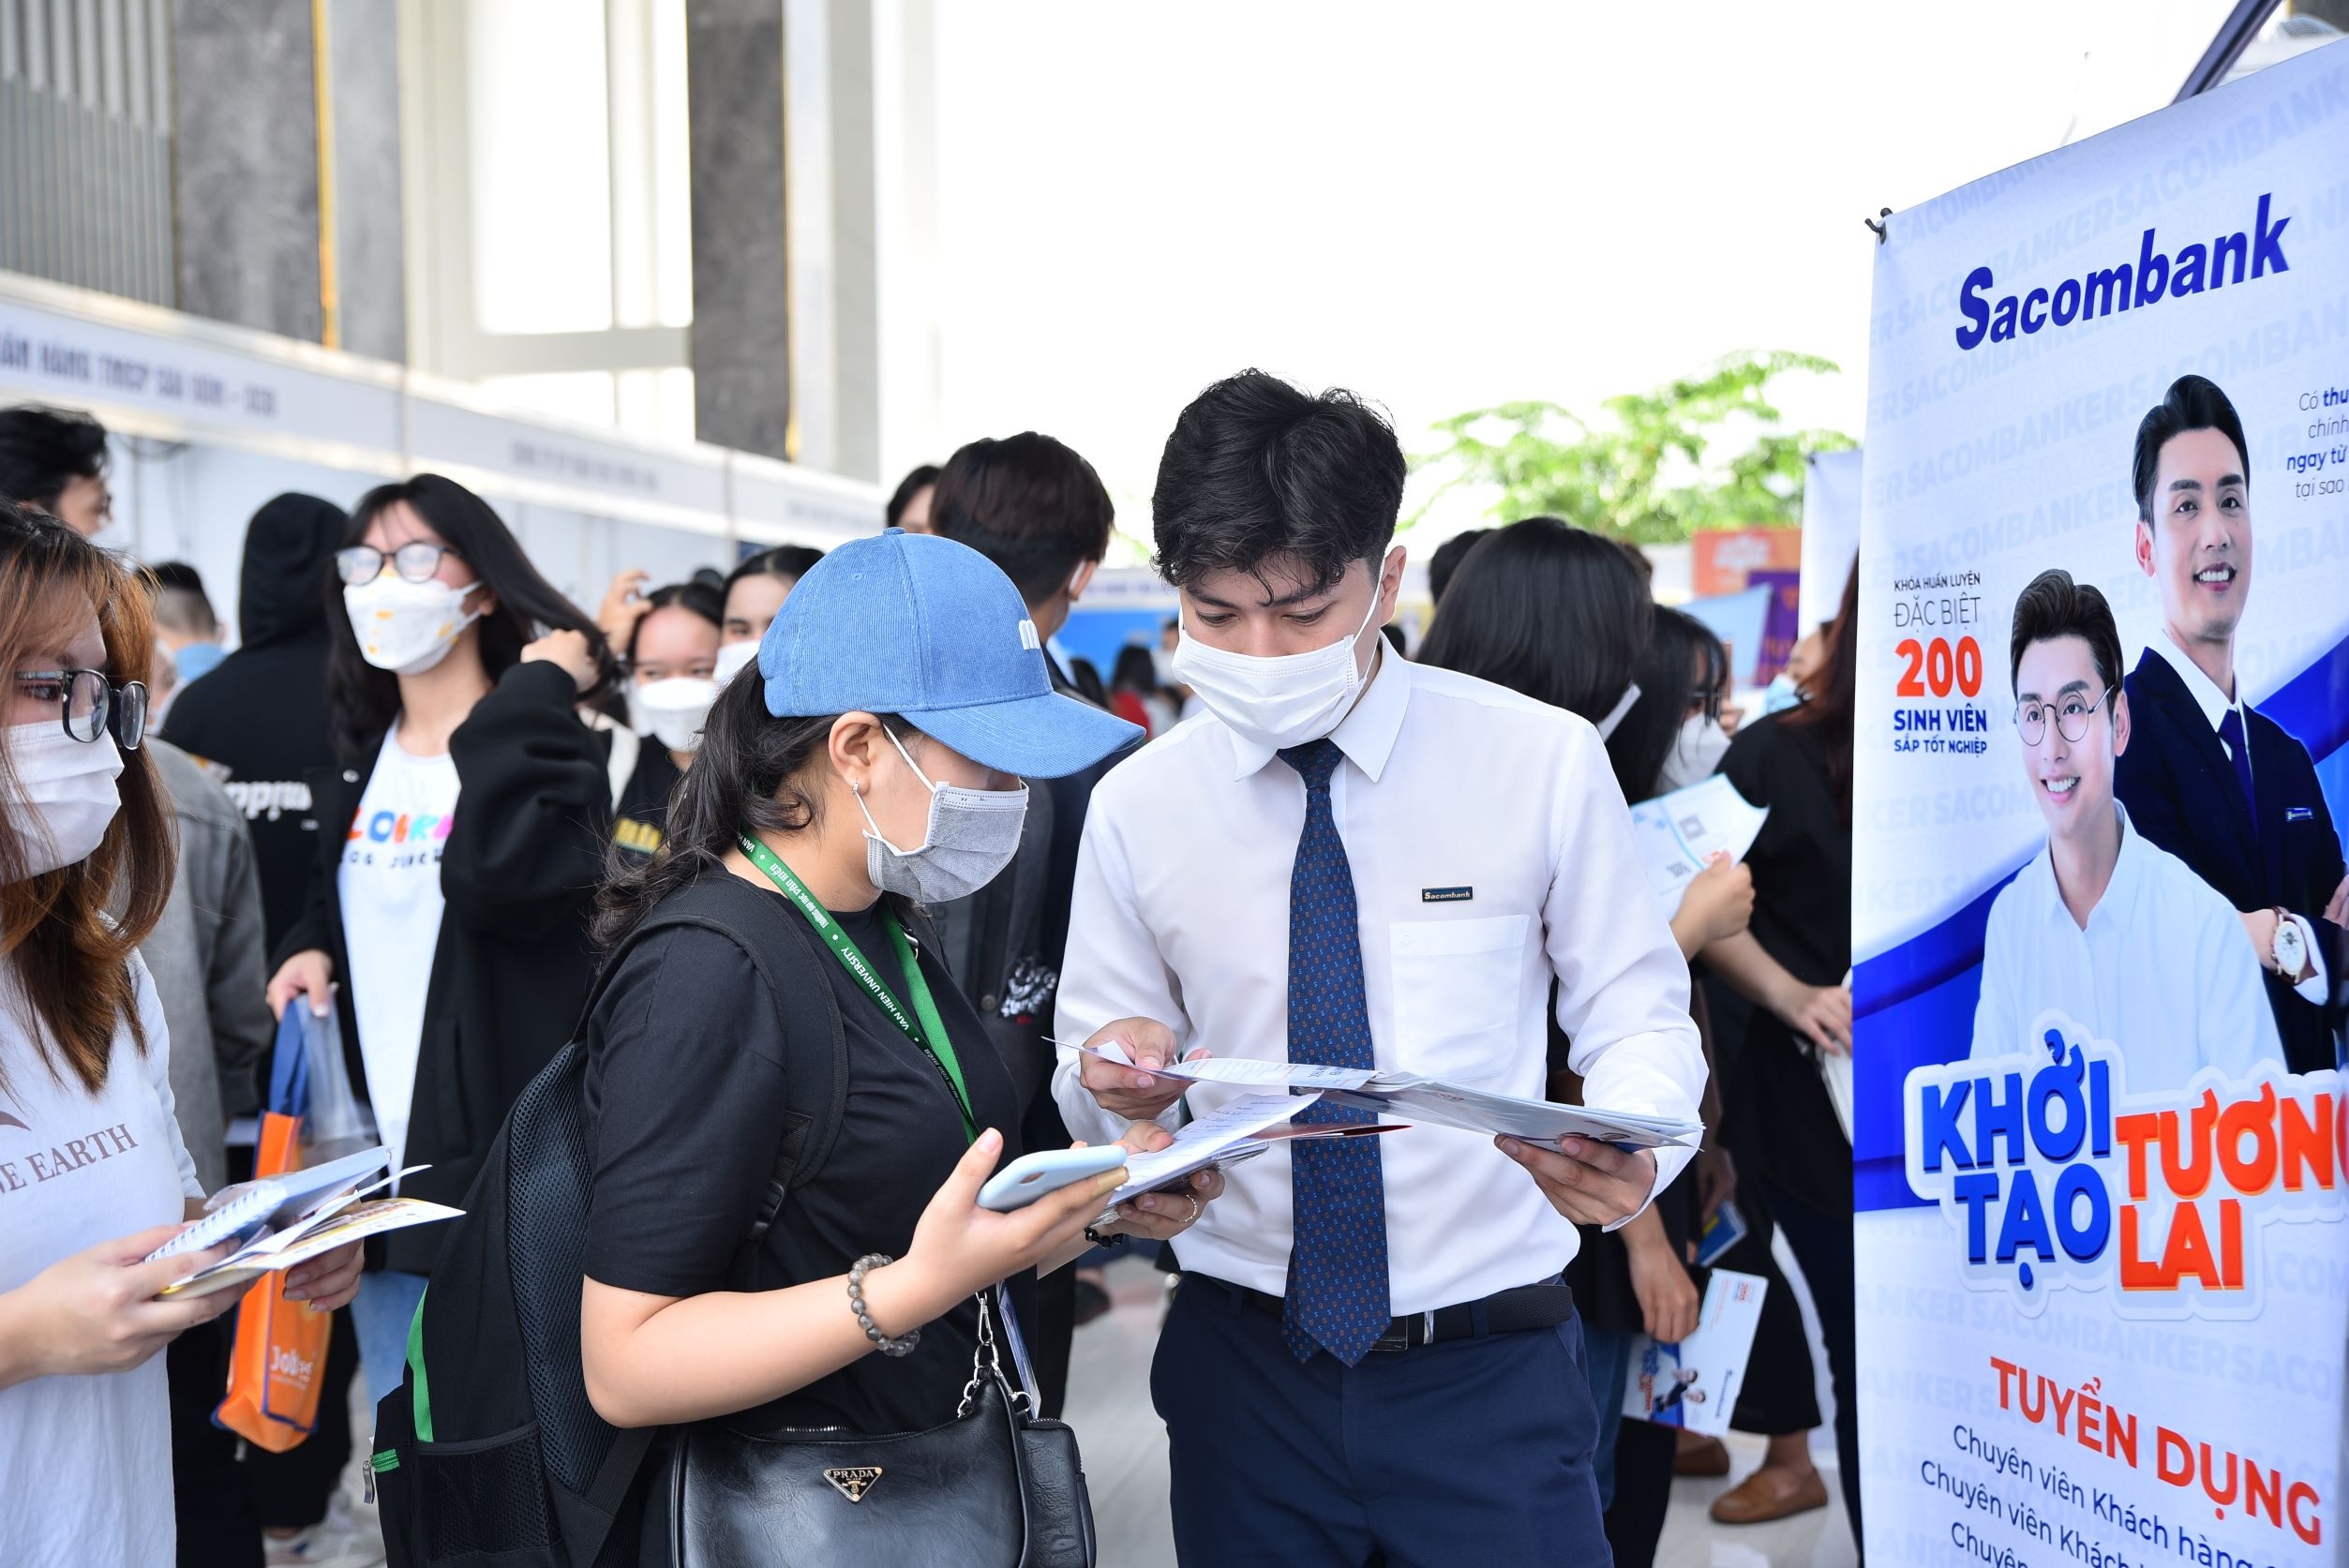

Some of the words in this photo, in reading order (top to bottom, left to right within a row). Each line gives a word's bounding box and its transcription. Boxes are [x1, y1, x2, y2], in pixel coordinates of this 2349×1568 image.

[1955, 192, 2292, 351] Sacombank
[2299, 390, 2319, 411] Có
[2308, 414, 2349, 439] chính
[2286, 452, 2327, 473] ngay
[2330, 443, 2347, 465] từ
[2295, 477, 2315, 501] tại
[2318, 479, 2344, 495] sao
[1893, 575, 1922, 592] KHÓA
[1923, 572, 1948, 590] HUẤN
[1950, 570, 1981, 590] LUYỆN
[1893, 595, 1936, 633] ĐẶC
[1940, 591, 1982, 630] BIỆT
[1894, 635, 1982, 698] 200
[1893, 709, 1940, 731] SINH
[1946, 702, 1987, 732] VIÊN
[1893, 733, 1920, 753] SẮP
[1923, 734, 1945, 753] TỐT
[1948, 736, 1987, 758] NGHIỆP
[1424, 890, 1471, 900] Sacombank
[840, 947, 881, 993] UNIVERSITY
[877, 991, 897, 1012] HIEN
[893, 1011, 909, 1031] VAN
[1921, 1028, 2111, 1172] KHỞI
[2115, 1081, 2349, 1201] TƯƠN
[0, 1161, 27, 1194] E
[24, 1123, 139, 1183] EARTH
[1953, 1162, 2111, 1292] TẠO
[2118, 1198, 2245, 1291] LAI
[1989, 1355, 2137, 1470] TUYỂN
[2156, 1425, 2322, 1546] DỤNG
[832, 1470, 875, 1478] PRADA
[1953, 1424, 2033, 1484] Chuyên
[2039, 1465, 2085, 1509] viên
[2092, 1486, 2168, 1549] Khách
[1921, 1460, 2002, 1518] Chuyên
[2008, 1501, 2052, 1545] viên
